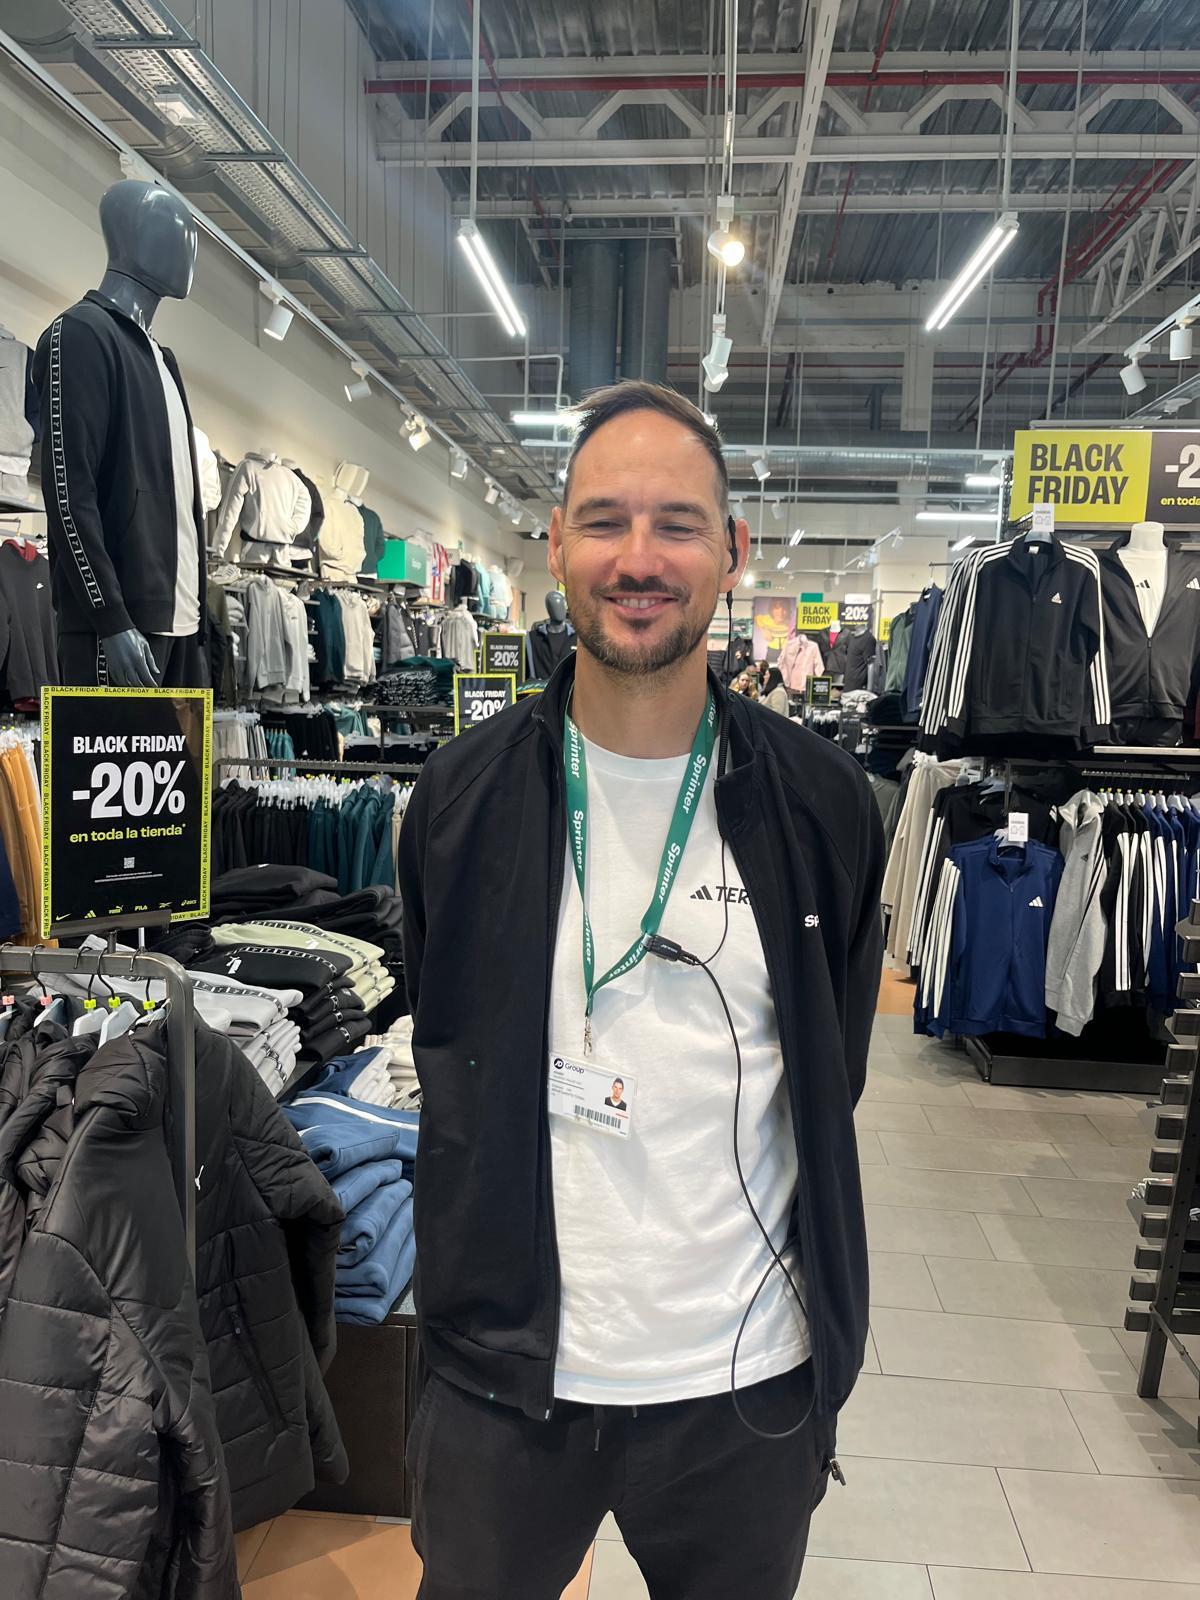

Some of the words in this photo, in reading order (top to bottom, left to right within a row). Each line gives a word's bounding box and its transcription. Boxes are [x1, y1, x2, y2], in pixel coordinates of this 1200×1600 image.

[1030, 444, 1124, 471] BLACK
[1165, 444, 1200, 488] -2
[1028, 476, 1128, 504] FRIDAY
[1161, 497, 1175, 505] en
[803, 616, 831, 624] FRIDAY
[841, 606, 869, 620] -20%
[490, 651, 518, 666] -20%
[73, 736, 128, 754] BLACK
[132, 736, 186, 752] FRIDAY
[73, 760, 186, 818] -20%
[683, 754, 707, 814] Sprinter
[70, 833, 88, 843] en
[91, 828, 124, 841] toda
[126, 828, 138, 838] la
[573, 811, 584, 872] Sprinter
[658, 843, 681, 904] Sprinter
[716, 886, 752, 906] TER
[564, 1063, 584, 1074] Group
